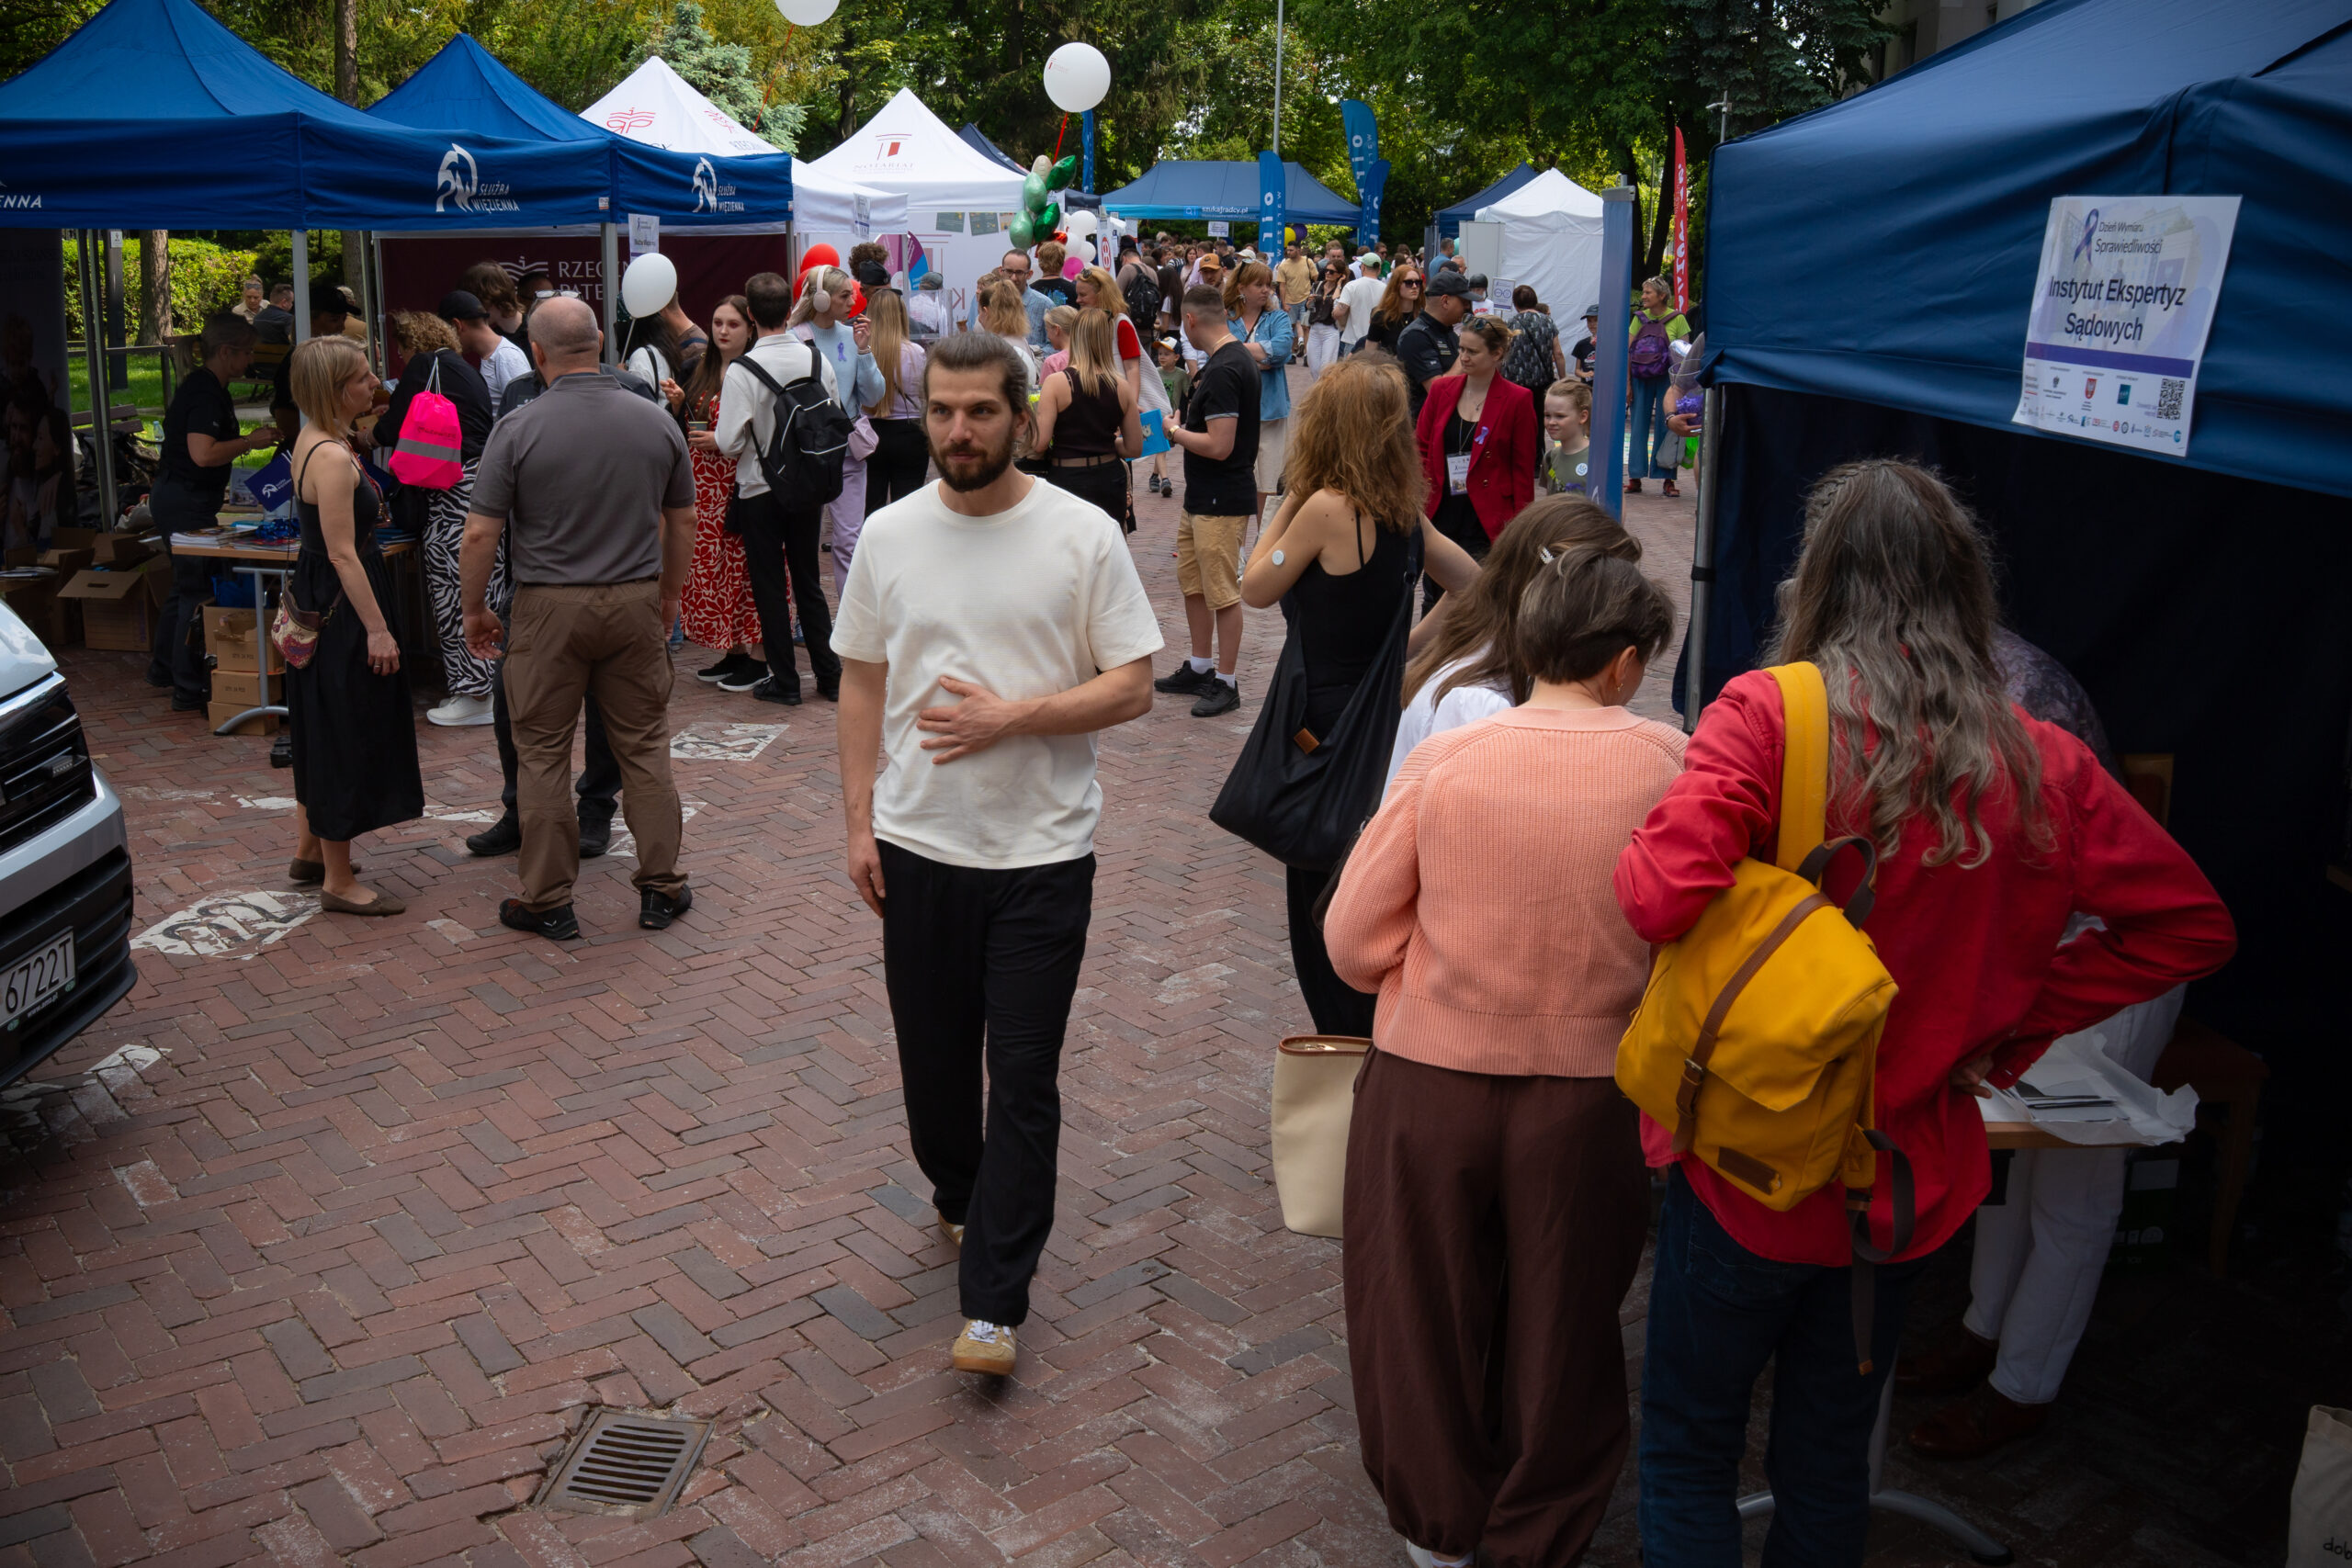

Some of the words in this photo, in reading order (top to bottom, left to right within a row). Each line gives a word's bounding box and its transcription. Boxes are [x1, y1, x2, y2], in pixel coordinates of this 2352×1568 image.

[471, 198, 520, 214] WIĘZIENNA
[2095, 238, 2164, 254] Sprawiedliwości
[2049, 276, 2104, 304] Instytut
[2106, 278, 2187, 311] Ekspertyz
[2064, 312, 2143, 344] Sądowych
[5, 937, 71, 1014] 6722T
[2323, 1537, 2352, 1561] dob
